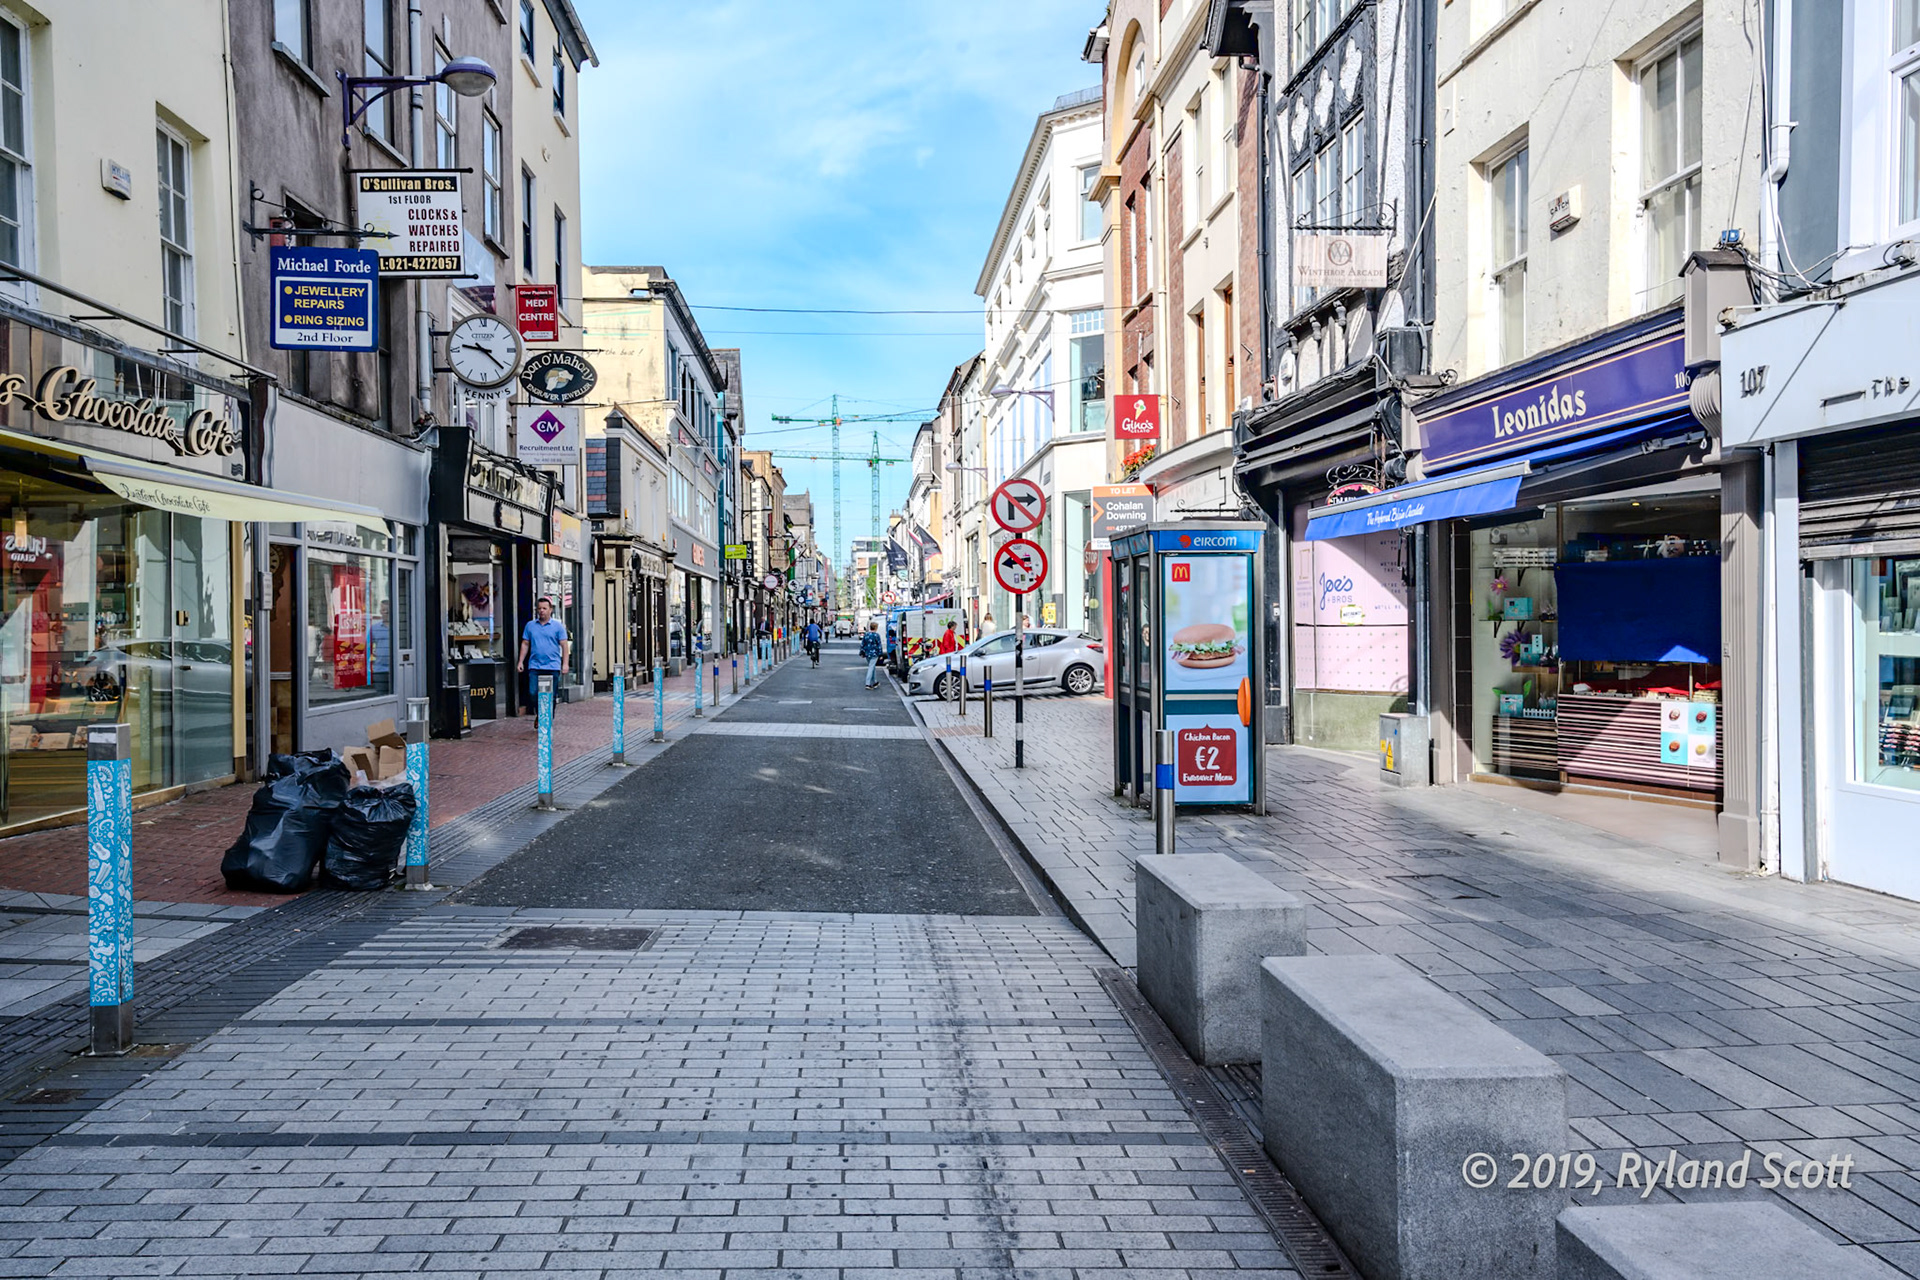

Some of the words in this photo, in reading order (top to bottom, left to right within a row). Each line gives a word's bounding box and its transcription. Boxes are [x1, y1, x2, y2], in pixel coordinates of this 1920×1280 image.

[362, 178, 421, 190] O'Sullivan
[424, 178, 454, 190] Bros.
[388, 195, 402, 204] 1st
[404, 195, 432, 204] FLOOR
[408, 208, 448, 220] CLOCKS
[450, 210, 458, 220] &
[408, 224, 458, 236] WATCHES
[410, 240, 460, 252] REPAIRED
[278, 258, 328, 272] Michael
[334, 260, 371, 273] Forde
[294, 286, 365, 297] JEWELLERY
[294, 299, 345, 310] REPAIRS
[294, 315, 322, 325] RING
[326, 316, 364, 326] SIZING
[519, 313, 554, 321] CENTRE
[297, 332, 318, 342] 2nd
[322, 332, 353, 342] Floor
[521, 360, 542, 380] Don
[542, 353, 594, 382] O'Mahony
[1674, 370, 1690, 389] 106
[1740, 365, 1770, 398] 107
[464, 388, 511, 400] KENNY'S
[526, 383, 559, 400] ENGRAVER
[562, 382, 592, 401] JEWELLER
[44, 366, 178, 441] Chocolate
[1491, 384, 1587, 438] Leonidas
[1122, 418, 1154, 430] Gino's
[1106, 502, 1143, 510] Cohalan
[1106, 511, 1146, 521] Downing
[1084, 552, 1097, 564] STOP
[1319, 572, 1353, 610] Joe's
[1184, 732, 1211, 741] Chicken
[1212, 733, 1230, 741] Bacon
[1195, 746, 1220, 770] €2
